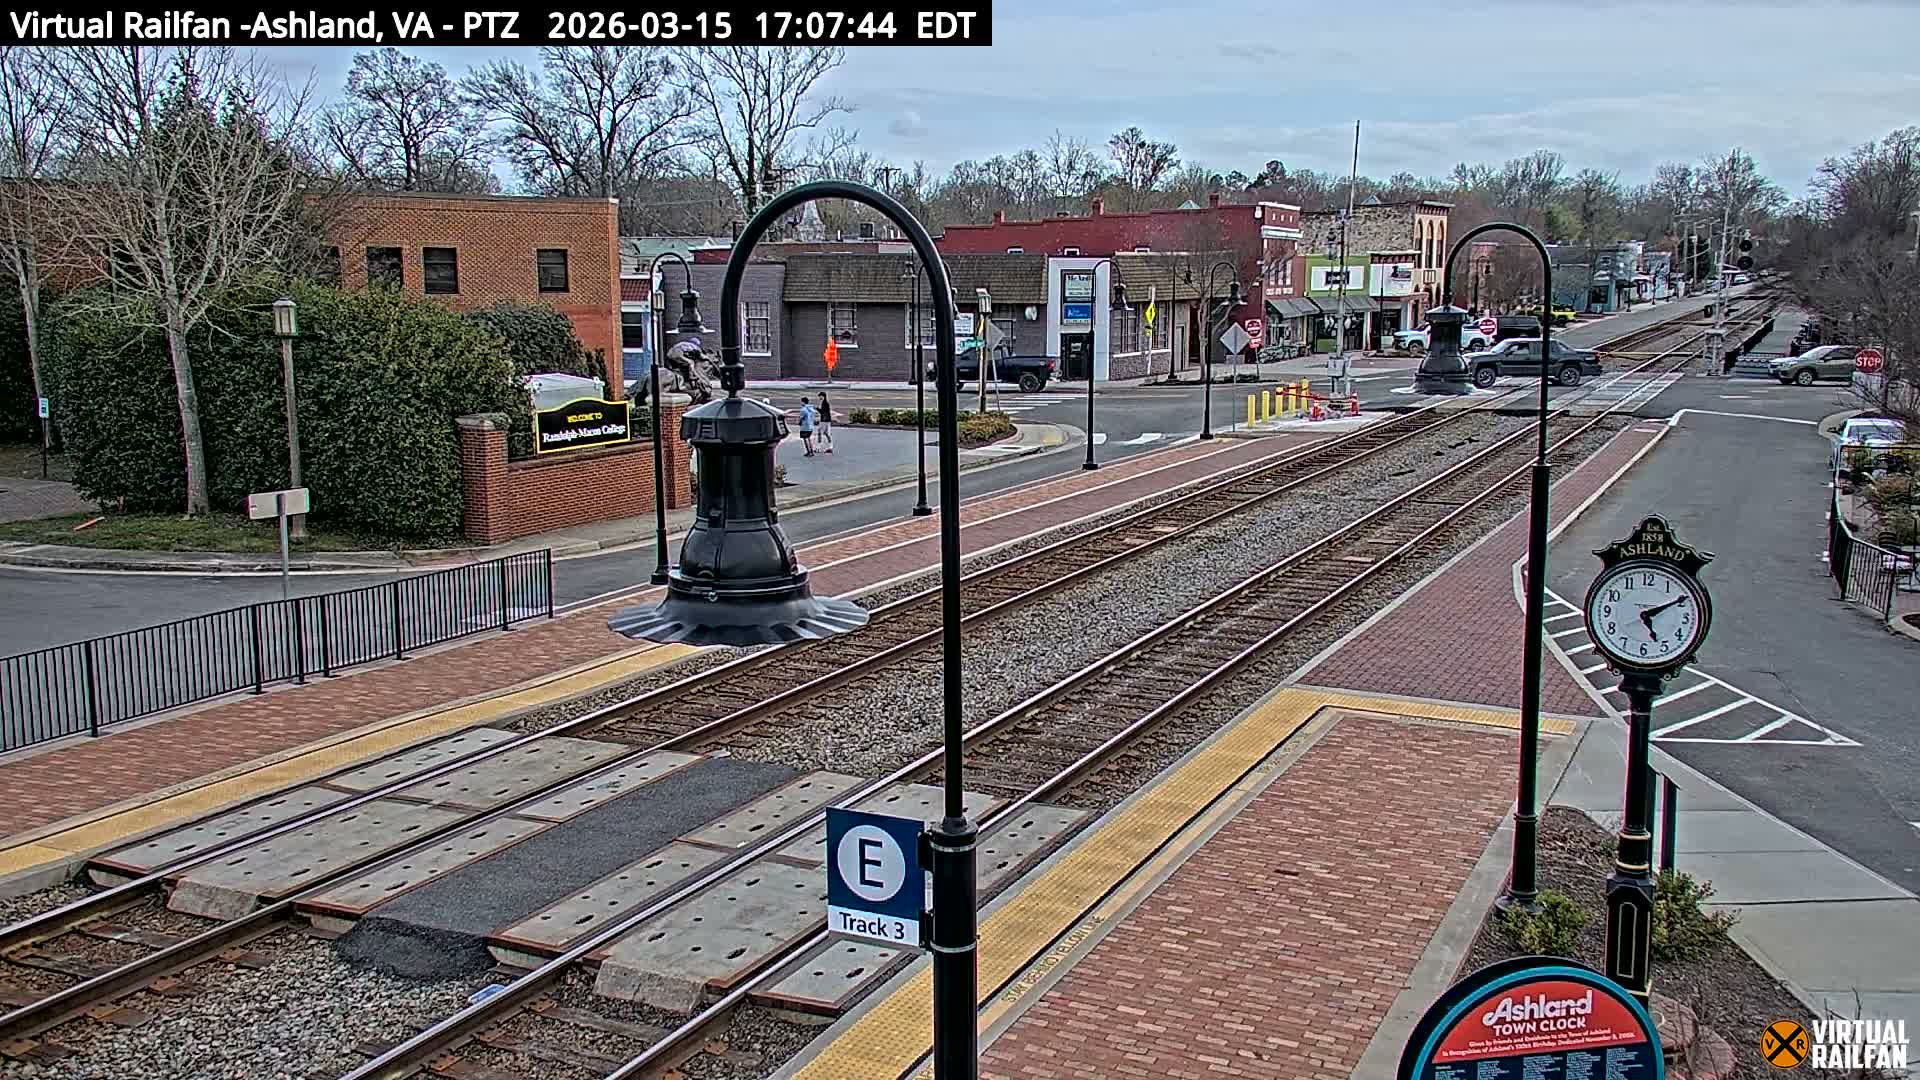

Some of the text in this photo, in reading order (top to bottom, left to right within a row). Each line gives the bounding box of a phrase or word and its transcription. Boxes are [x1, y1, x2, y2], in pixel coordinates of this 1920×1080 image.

[1856, 357, 1881, 367] STOP
[542, 424, 626, 442] Randolph-Macon College
[1642, 533, 1664, 542] 1858
[1620, 543, 1684, 560] ASHLAND
[1625, 577, 1634, 590] 11
[1643, 573, 1655, 586] 12
[1665, 581, 1670, 593] 1
[1608, 589, 1620, 602] 10
[1604, 605, 1612, 618] 9
[1682, 613, 1690, 624] 3
[1607, 622, 1616, 634] 8
[1675, 627, 1684, 640] 4
[1619, 637, 1628, 648] 7
[1640, 643, 1647, 655] 6
[1660, 641, 1668, 652] 5
[859, 838, 884, 888] E
[839, 912, 904, 940] Track 3
[1482, 990, 1592, 1026] Ashland
[1493, 1016, 1586, 1036] TOWN CLOCK
